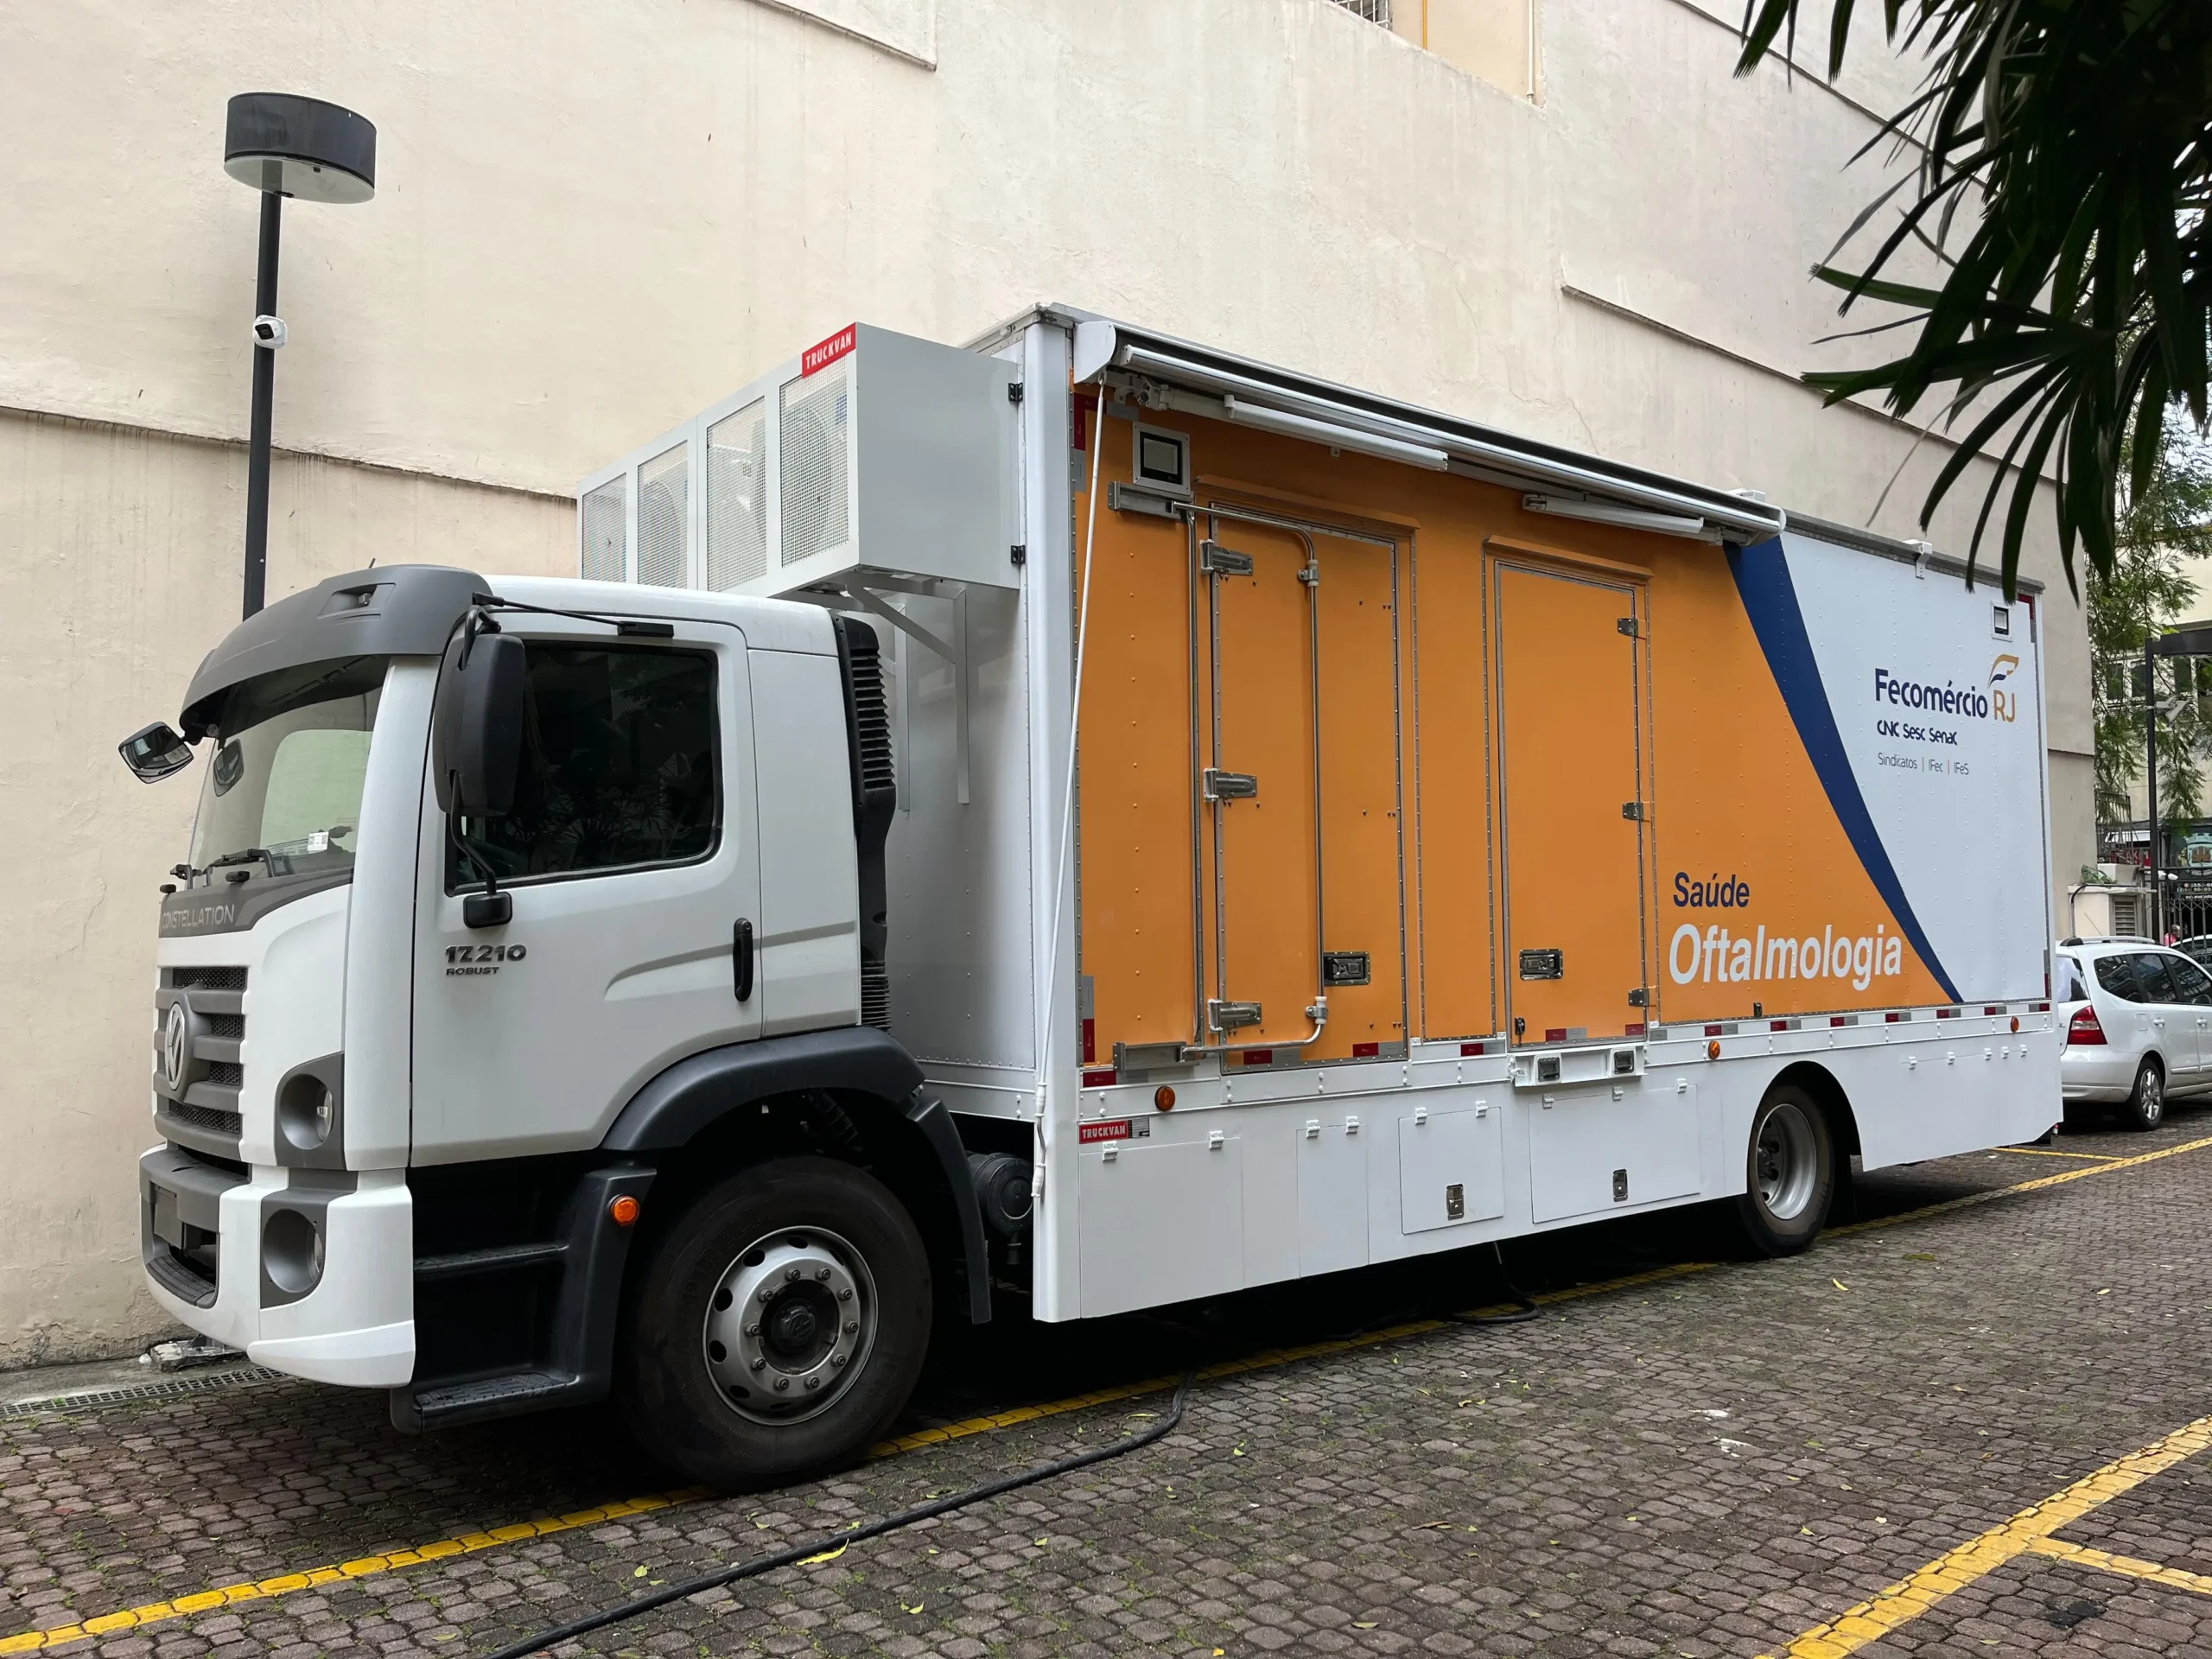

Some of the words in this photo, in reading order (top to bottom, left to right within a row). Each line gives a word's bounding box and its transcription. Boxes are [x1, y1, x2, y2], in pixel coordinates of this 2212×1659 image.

[805, 331, 852, 370] TRUCKVAN
[1874, 667, 1988, 718] Fecomércio
[1993, 690, 2016, 722] RJ
[1877, 720, 1899, 737] CNC
[1903, 723, 1925, 741] Sesc
[1929, 728, 1957, 745] Senac
[1878, 753, 1917, 769] Sindicatos
[1673, 872, 1750, 907] Saúde
[446, 967, 499, 976] ROBUST
[1669, 924, 1902, 991] Oftalmologia
[1082, 1125, 1126, 1139] TRUCKVAN
